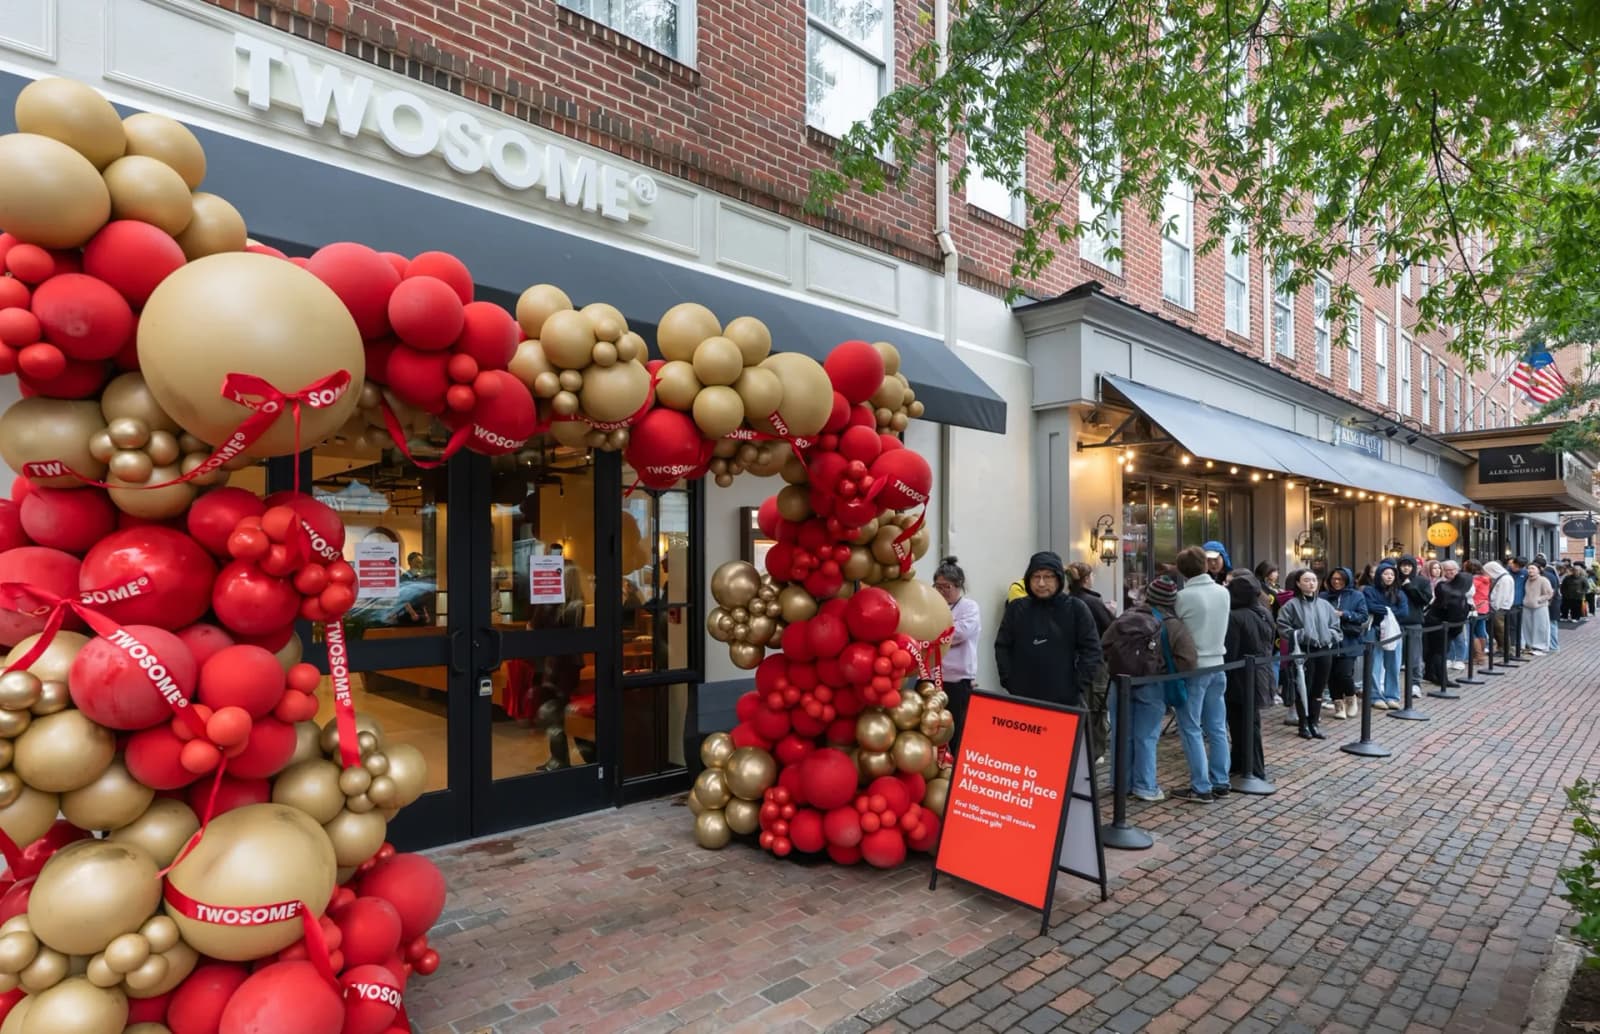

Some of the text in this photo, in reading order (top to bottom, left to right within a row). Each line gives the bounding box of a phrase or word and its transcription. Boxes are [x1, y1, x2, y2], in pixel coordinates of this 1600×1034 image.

[965, 749, 1021, 774] Welcome
[1024, 765, 1037, 778] to
[958, 778, 1034, 808] Alexandria!
[962, 763, 1057, 800] Twosome Place
[961, 812, 989, 825] exclusive
[968, 803, 980, 812] 100
[980, 808, 1000, 819] guests
[1000, 814, 1013, 822] will
[1013, 818, 1036, 830] receive
